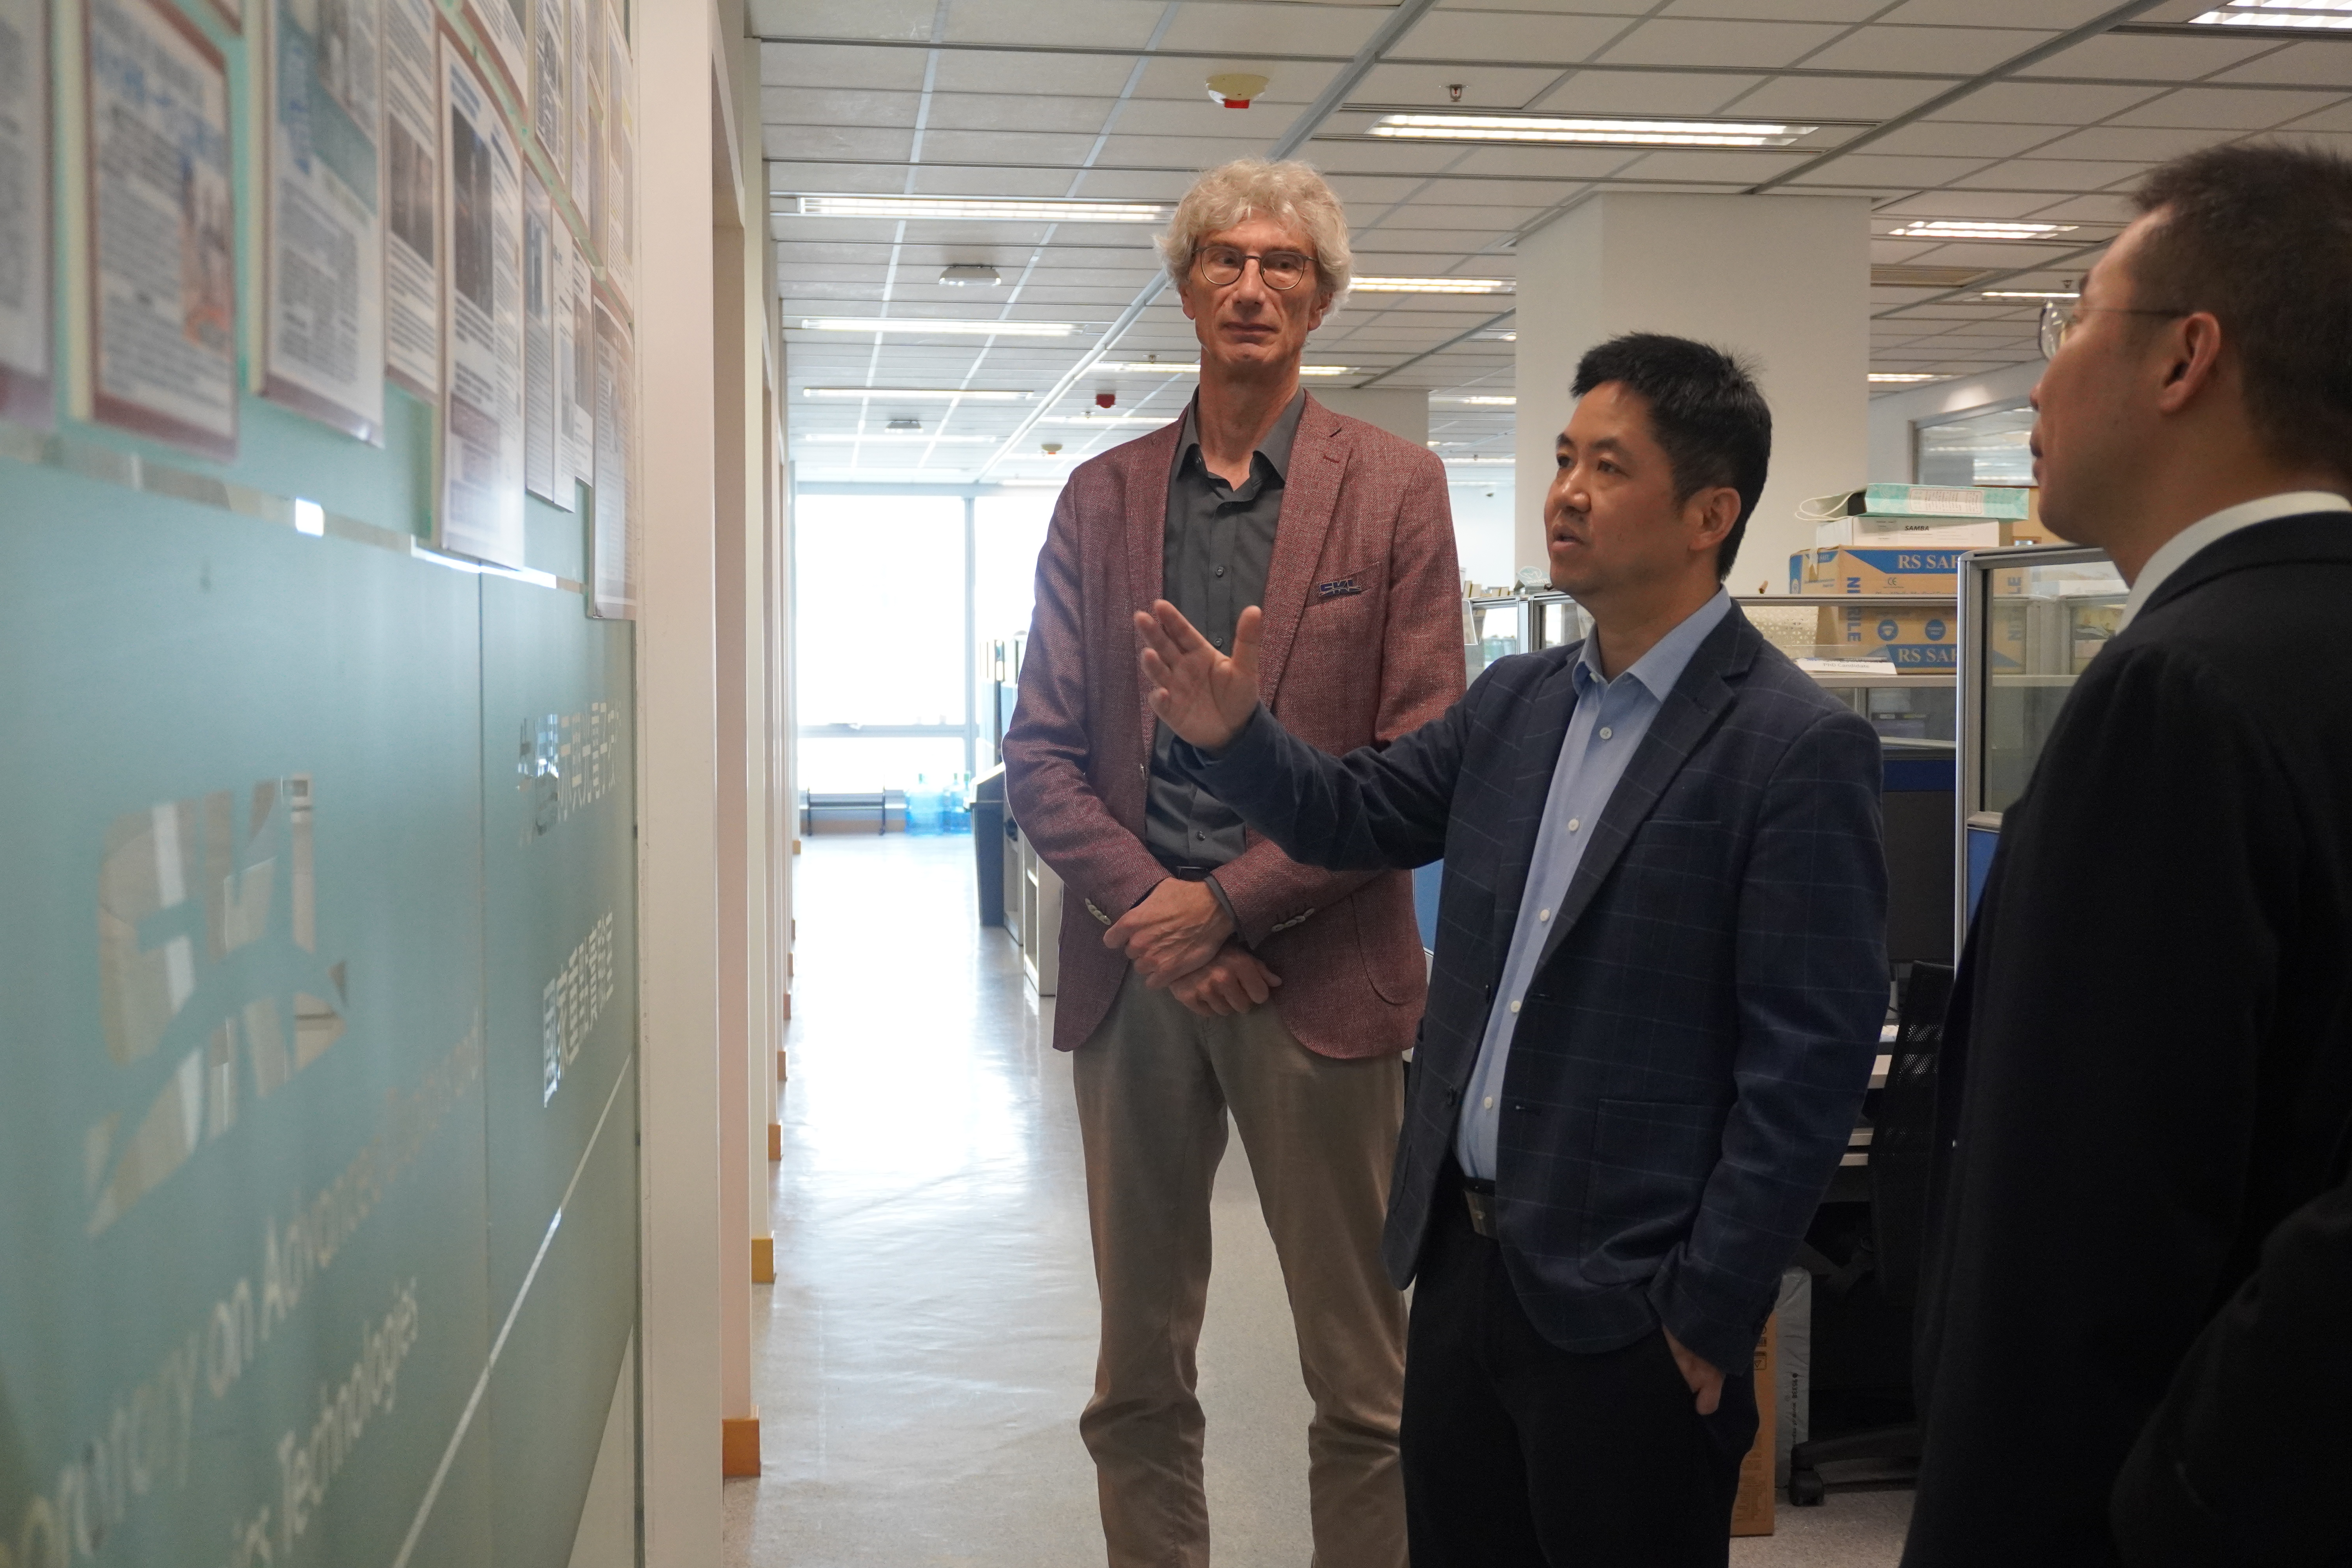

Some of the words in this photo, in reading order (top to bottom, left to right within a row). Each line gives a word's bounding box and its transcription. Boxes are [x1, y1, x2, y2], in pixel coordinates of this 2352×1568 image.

[1898, 555, 1921, 568] RS
[1847, 577, 1861, 642] NIRILE
[1898, 648, 1921, 662] RS
